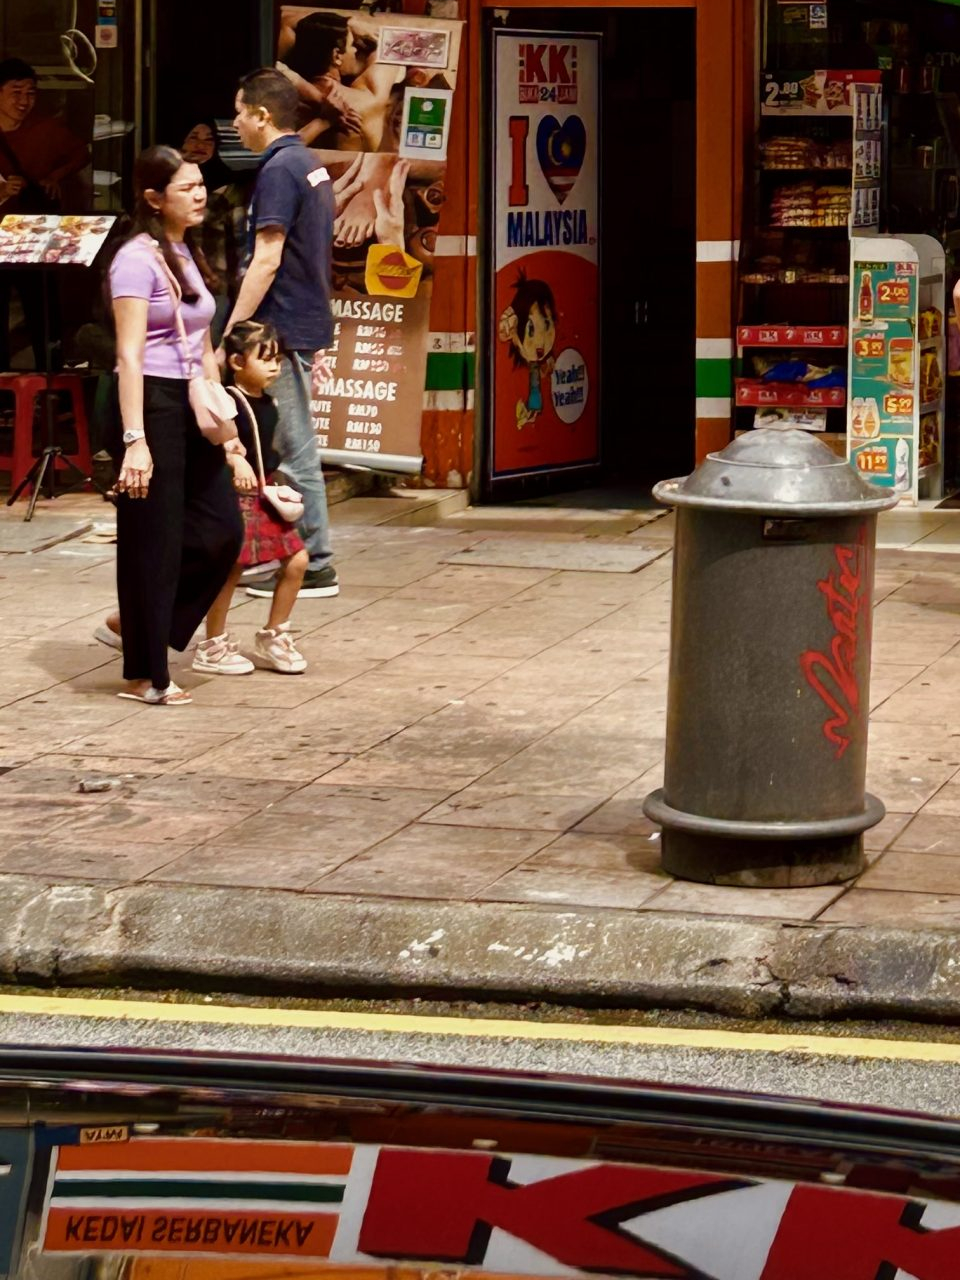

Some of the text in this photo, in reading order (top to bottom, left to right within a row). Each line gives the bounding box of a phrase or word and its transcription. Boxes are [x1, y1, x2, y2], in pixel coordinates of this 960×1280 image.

[526, 44, 570, 83] KK
[540, 86, 557, 102] 24
[509, 116, 530, 207] I
[507, 209, 589, 248] MALAYSIA
[330, 298, 404, 323] MASSAGE
[318, 378, 398, 402] MASSAGE
